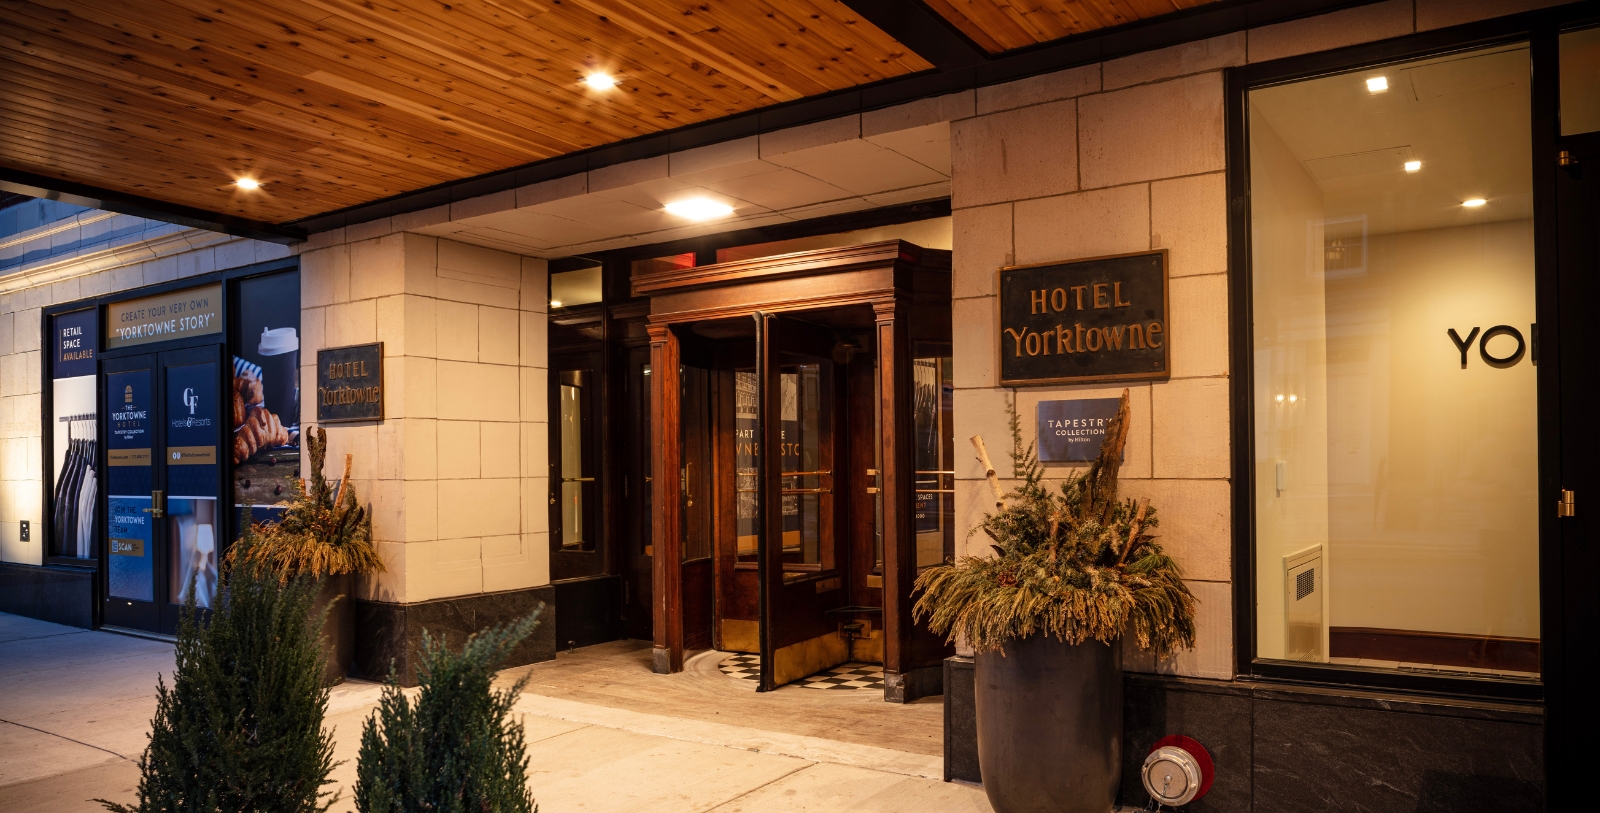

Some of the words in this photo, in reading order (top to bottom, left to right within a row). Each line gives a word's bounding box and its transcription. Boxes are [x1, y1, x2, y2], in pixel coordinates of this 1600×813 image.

[1030, 281, 1131, 315] HOTEL
[121, 309, 145, 323] CREATE
[148, 304, 167, 318] YOUR
[169, 302, 187, 316] VERY
[190, 298, 209, 311] OWN
[63, 326, 83, 338] RETAIL
[115, 319, 176, 341] "YORKTOWNE
[179, 313, 215, 331] STORY"
[63, 338, 81, 350] SPACE
[1004, 321, 1163, 358] Yorktowne
[1447, 324, 1537, 368] YO
[63, 349, 93, 361] AVAILABLE
[329, 360, 369, 380] HOTEL
[317, 385, 380, 406] Yorktowne
[112, 410, 147, 421] YORKTOWNE
[117, 420, 141, 428] HOTEL
[1055, 428, 1105, 436] COLLECTION
[127, 506, 136, 514] THE
[114, 515, 145, 525] YORKTOWNE
[118, 542, 132, 551] SCAN
